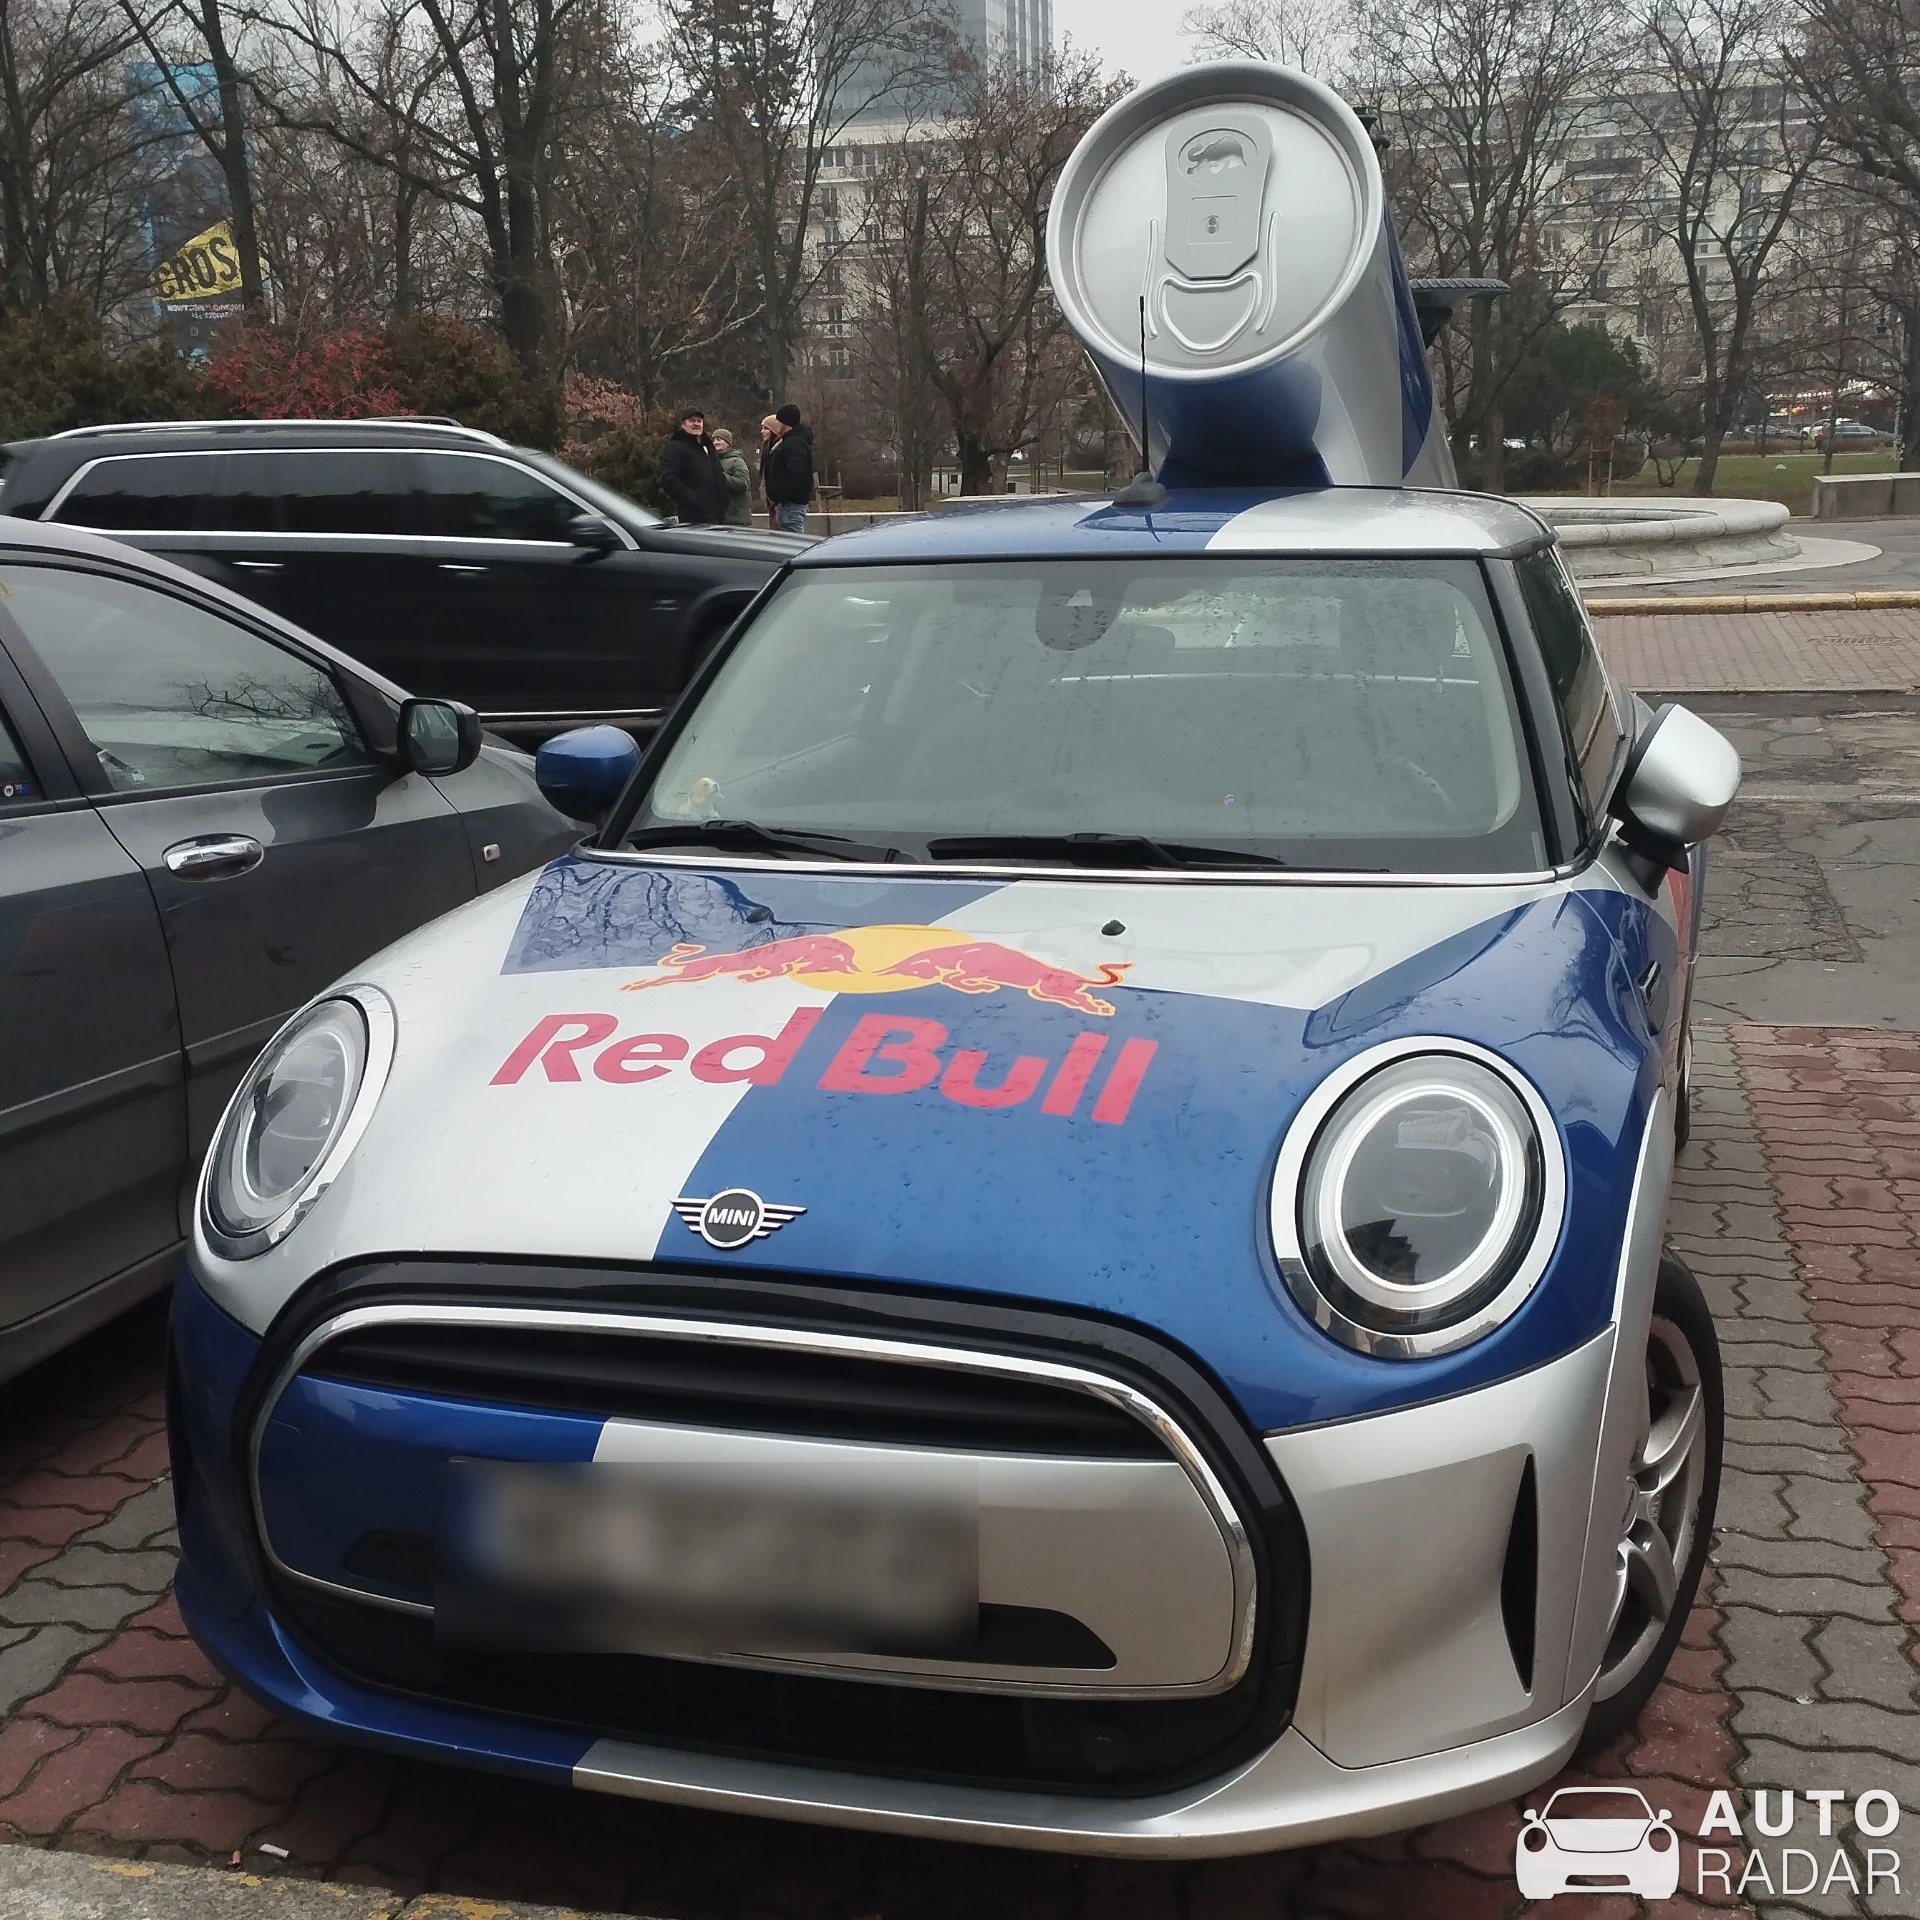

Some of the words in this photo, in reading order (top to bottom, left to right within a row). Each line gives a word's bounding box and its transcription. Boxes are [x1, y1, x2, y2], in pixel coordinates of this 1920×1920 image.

[488, 1007, 824, 1086] Red
[817, 1013, 1158, 1125] Bull
[707, 1207, 756, 1227] MINI
